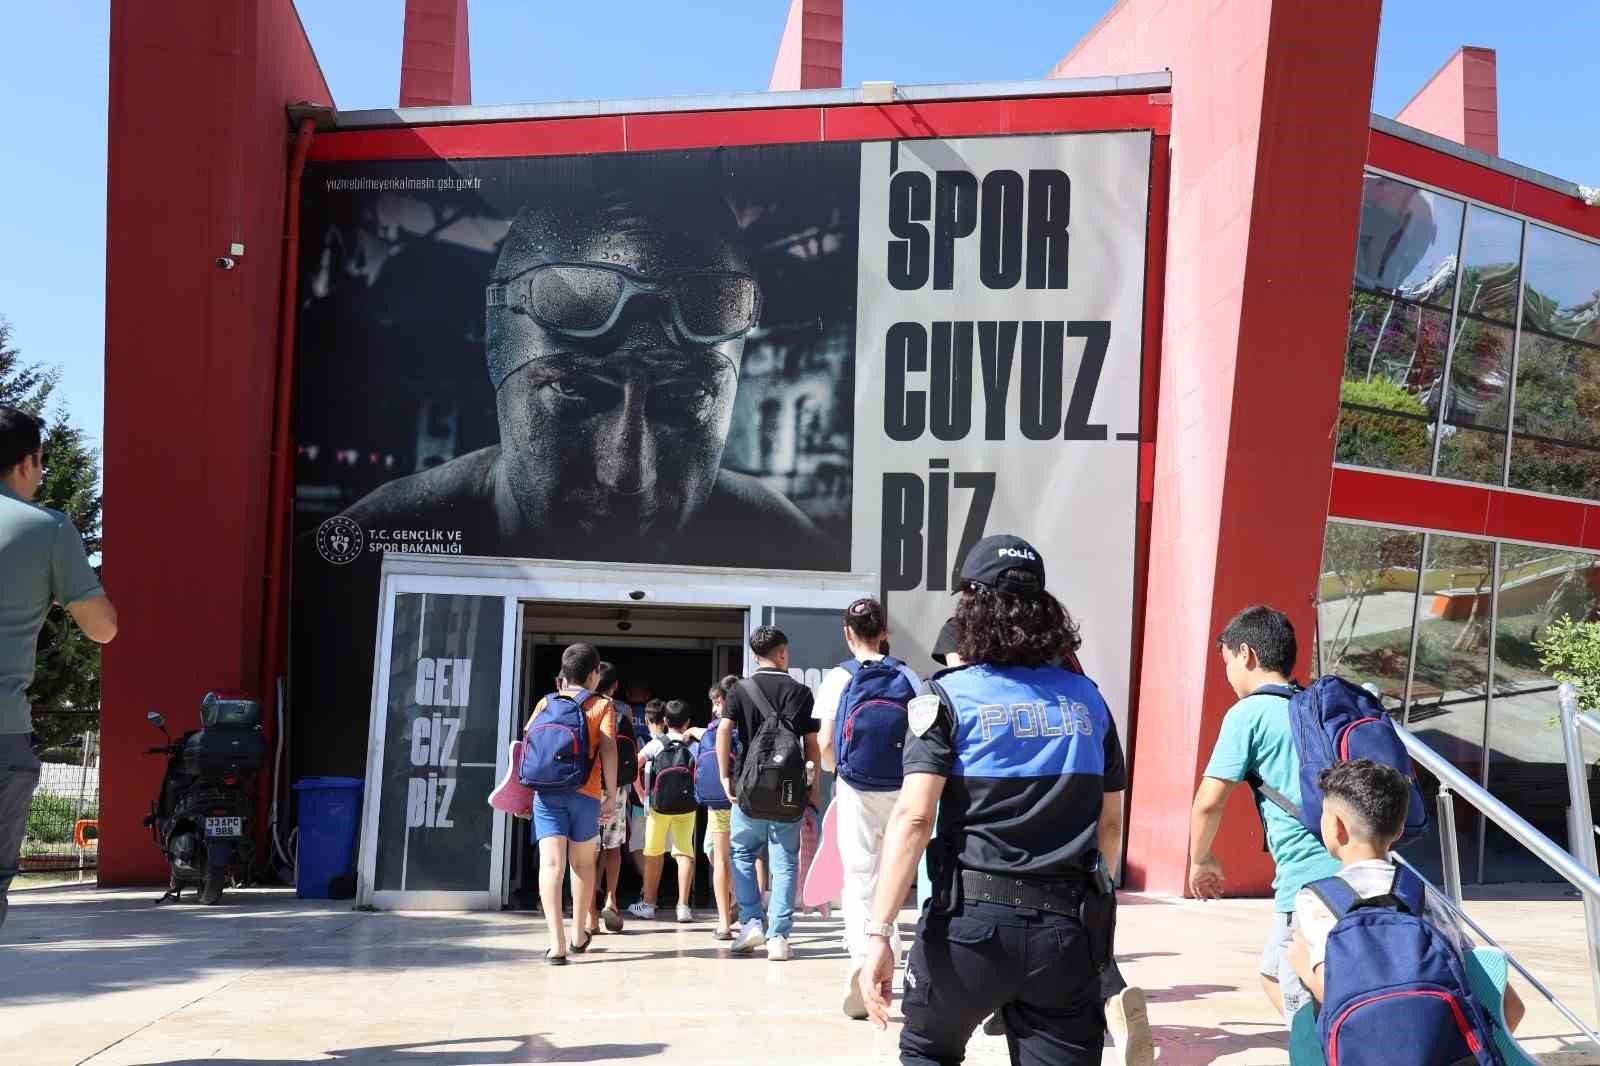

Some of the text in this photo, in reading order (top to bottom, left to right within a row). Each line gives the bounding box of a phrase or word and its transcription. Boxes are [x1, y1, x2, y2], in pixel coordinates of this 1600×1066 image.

[887, 168, 1071, 291] SPOR
[369, 529, 462, 542] T.C. GENÇLİK VE
[369, 542, 462, 553] SPOR BAKANLIĞI
[880, 458, 996, 592] BİZ
[415, 658, 472, 706] GEN
[411, 712, 460, 766] CİZ
[978, 695, 1094, 742] POLİS
[406, 772, 456, 828] BİZ
